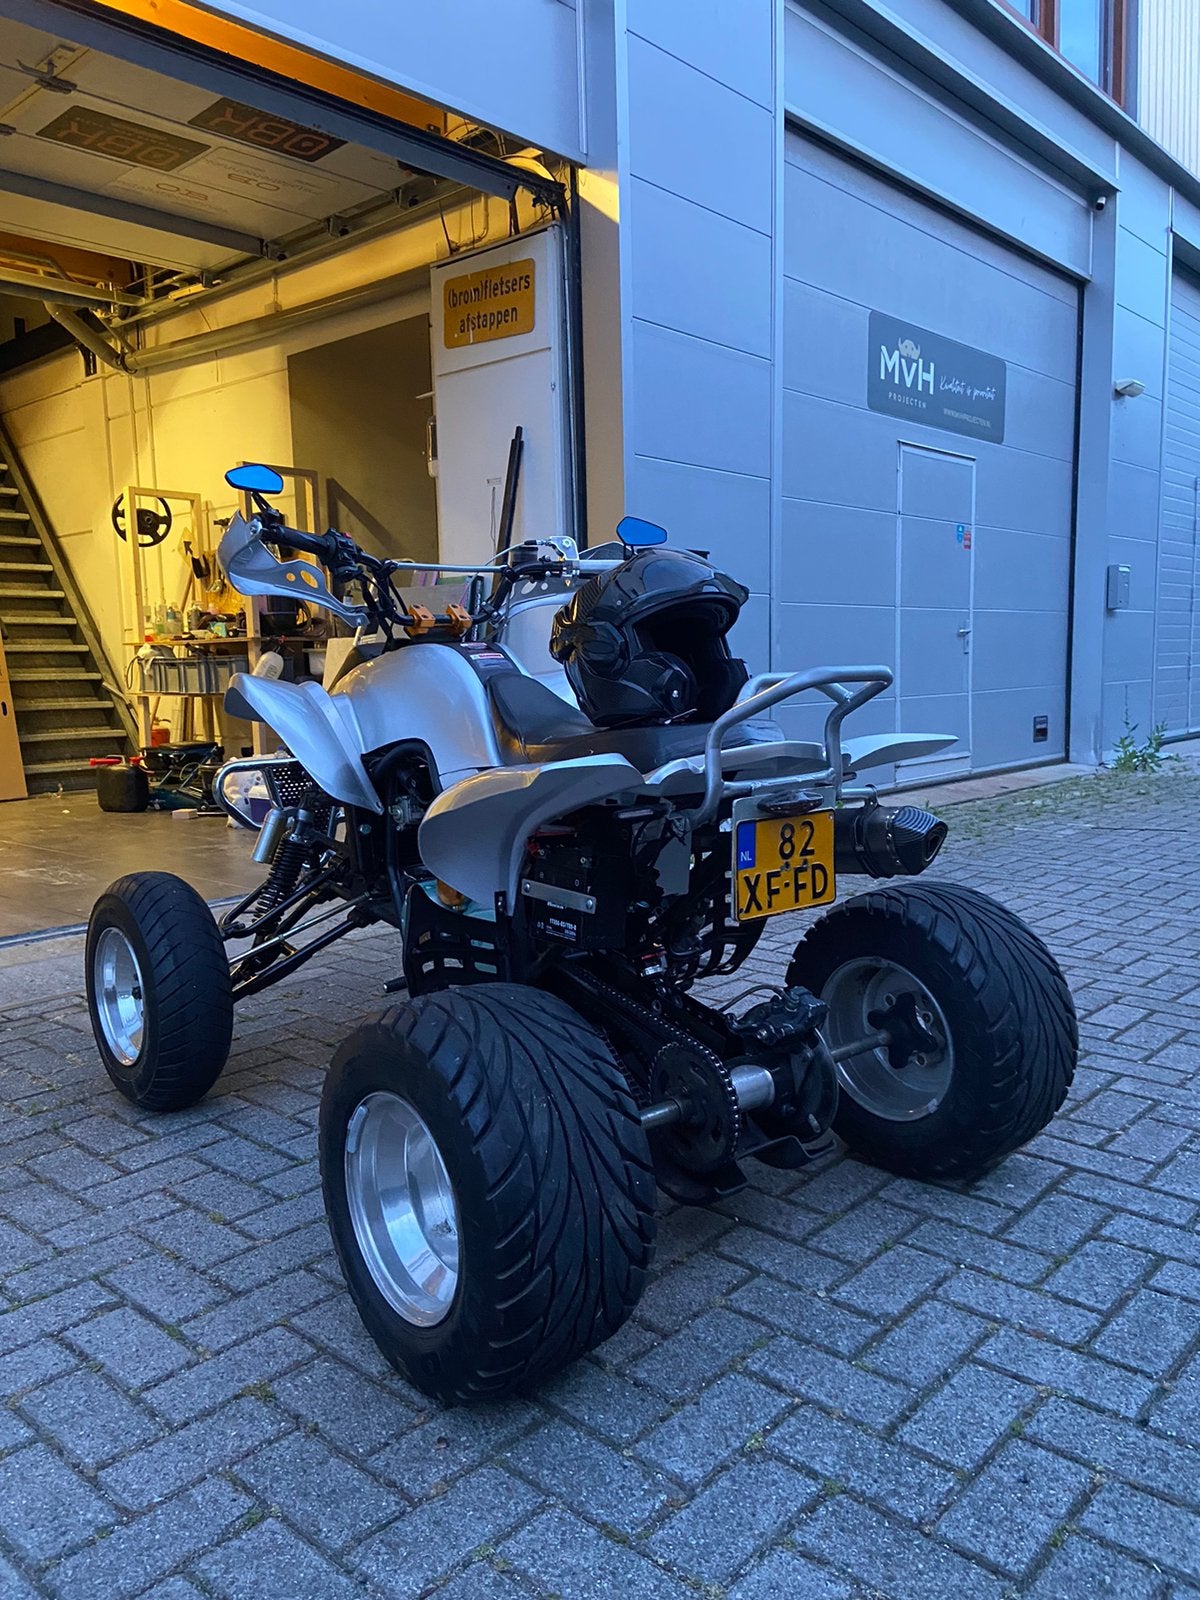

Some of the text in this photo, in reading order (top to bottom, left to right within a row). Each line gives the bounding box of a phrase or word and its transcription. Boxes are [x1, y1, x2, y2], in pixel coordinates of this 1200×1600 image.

[448, 274, 530, 309] (brom)fietsers
[459, 307, 518, 334] afstappen
[888, 391, 928, 409] PROJECTEN
[779, 820, 815, 860] 82
[740, 850, 753, 862] NL
[743, 863, 828, 913] XF-FD
